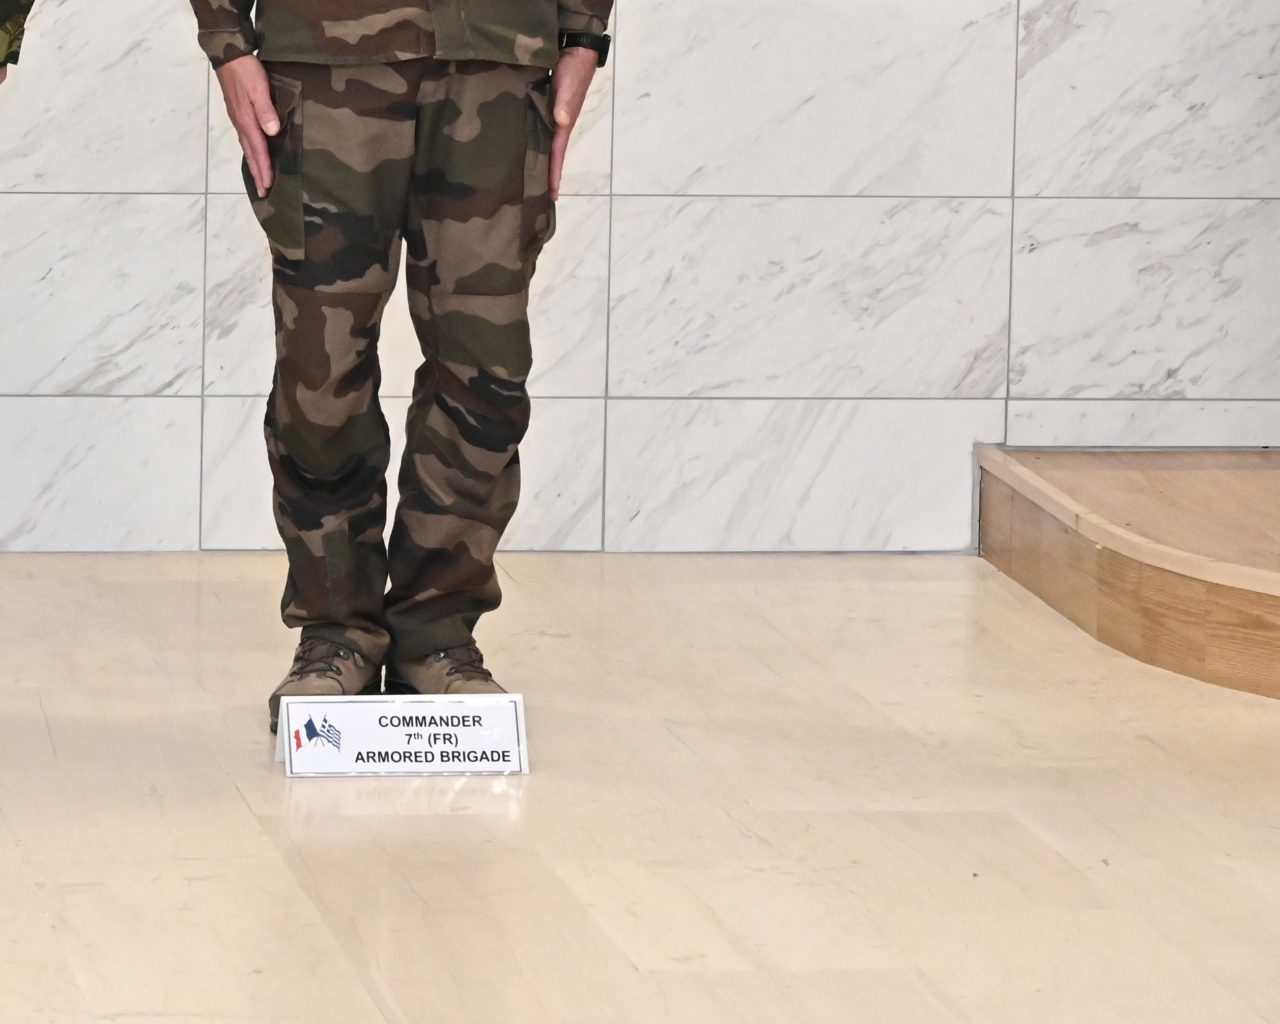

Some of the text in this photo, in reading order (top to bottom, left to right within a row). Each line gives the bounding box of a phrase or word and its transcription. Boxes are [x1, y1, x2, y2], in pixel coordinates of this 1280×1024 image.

[378, 715, 483, 728] COMMANDER
[405, 732, 459, 748] 7th (FR)
[354, 750, 511, 764] ARMORED BRIGADE
